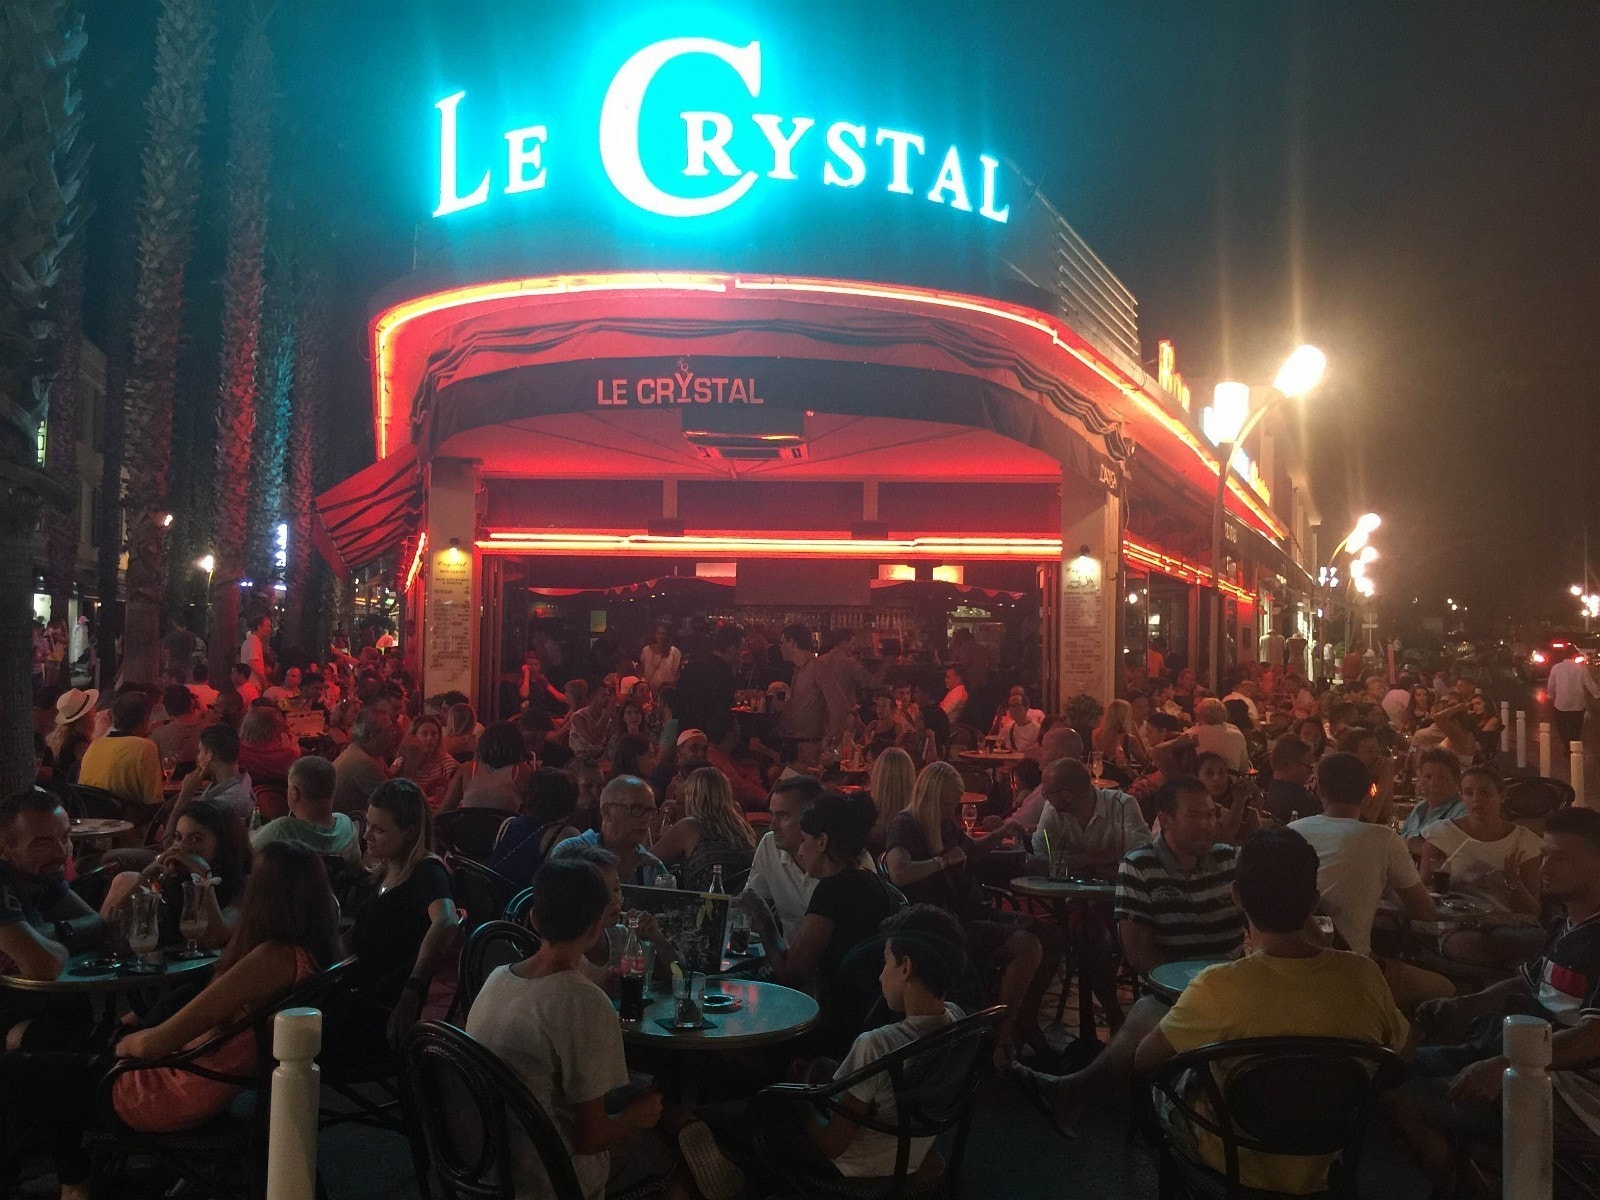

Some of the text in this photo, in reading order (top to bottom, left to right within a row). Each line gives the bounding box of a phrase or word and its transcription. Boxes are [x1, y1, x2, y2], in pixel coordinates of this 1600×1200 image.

[432, 37, 1010, 223] LE CRYSTAL
[597, 372, 764, 405] LE CRYSTAL
